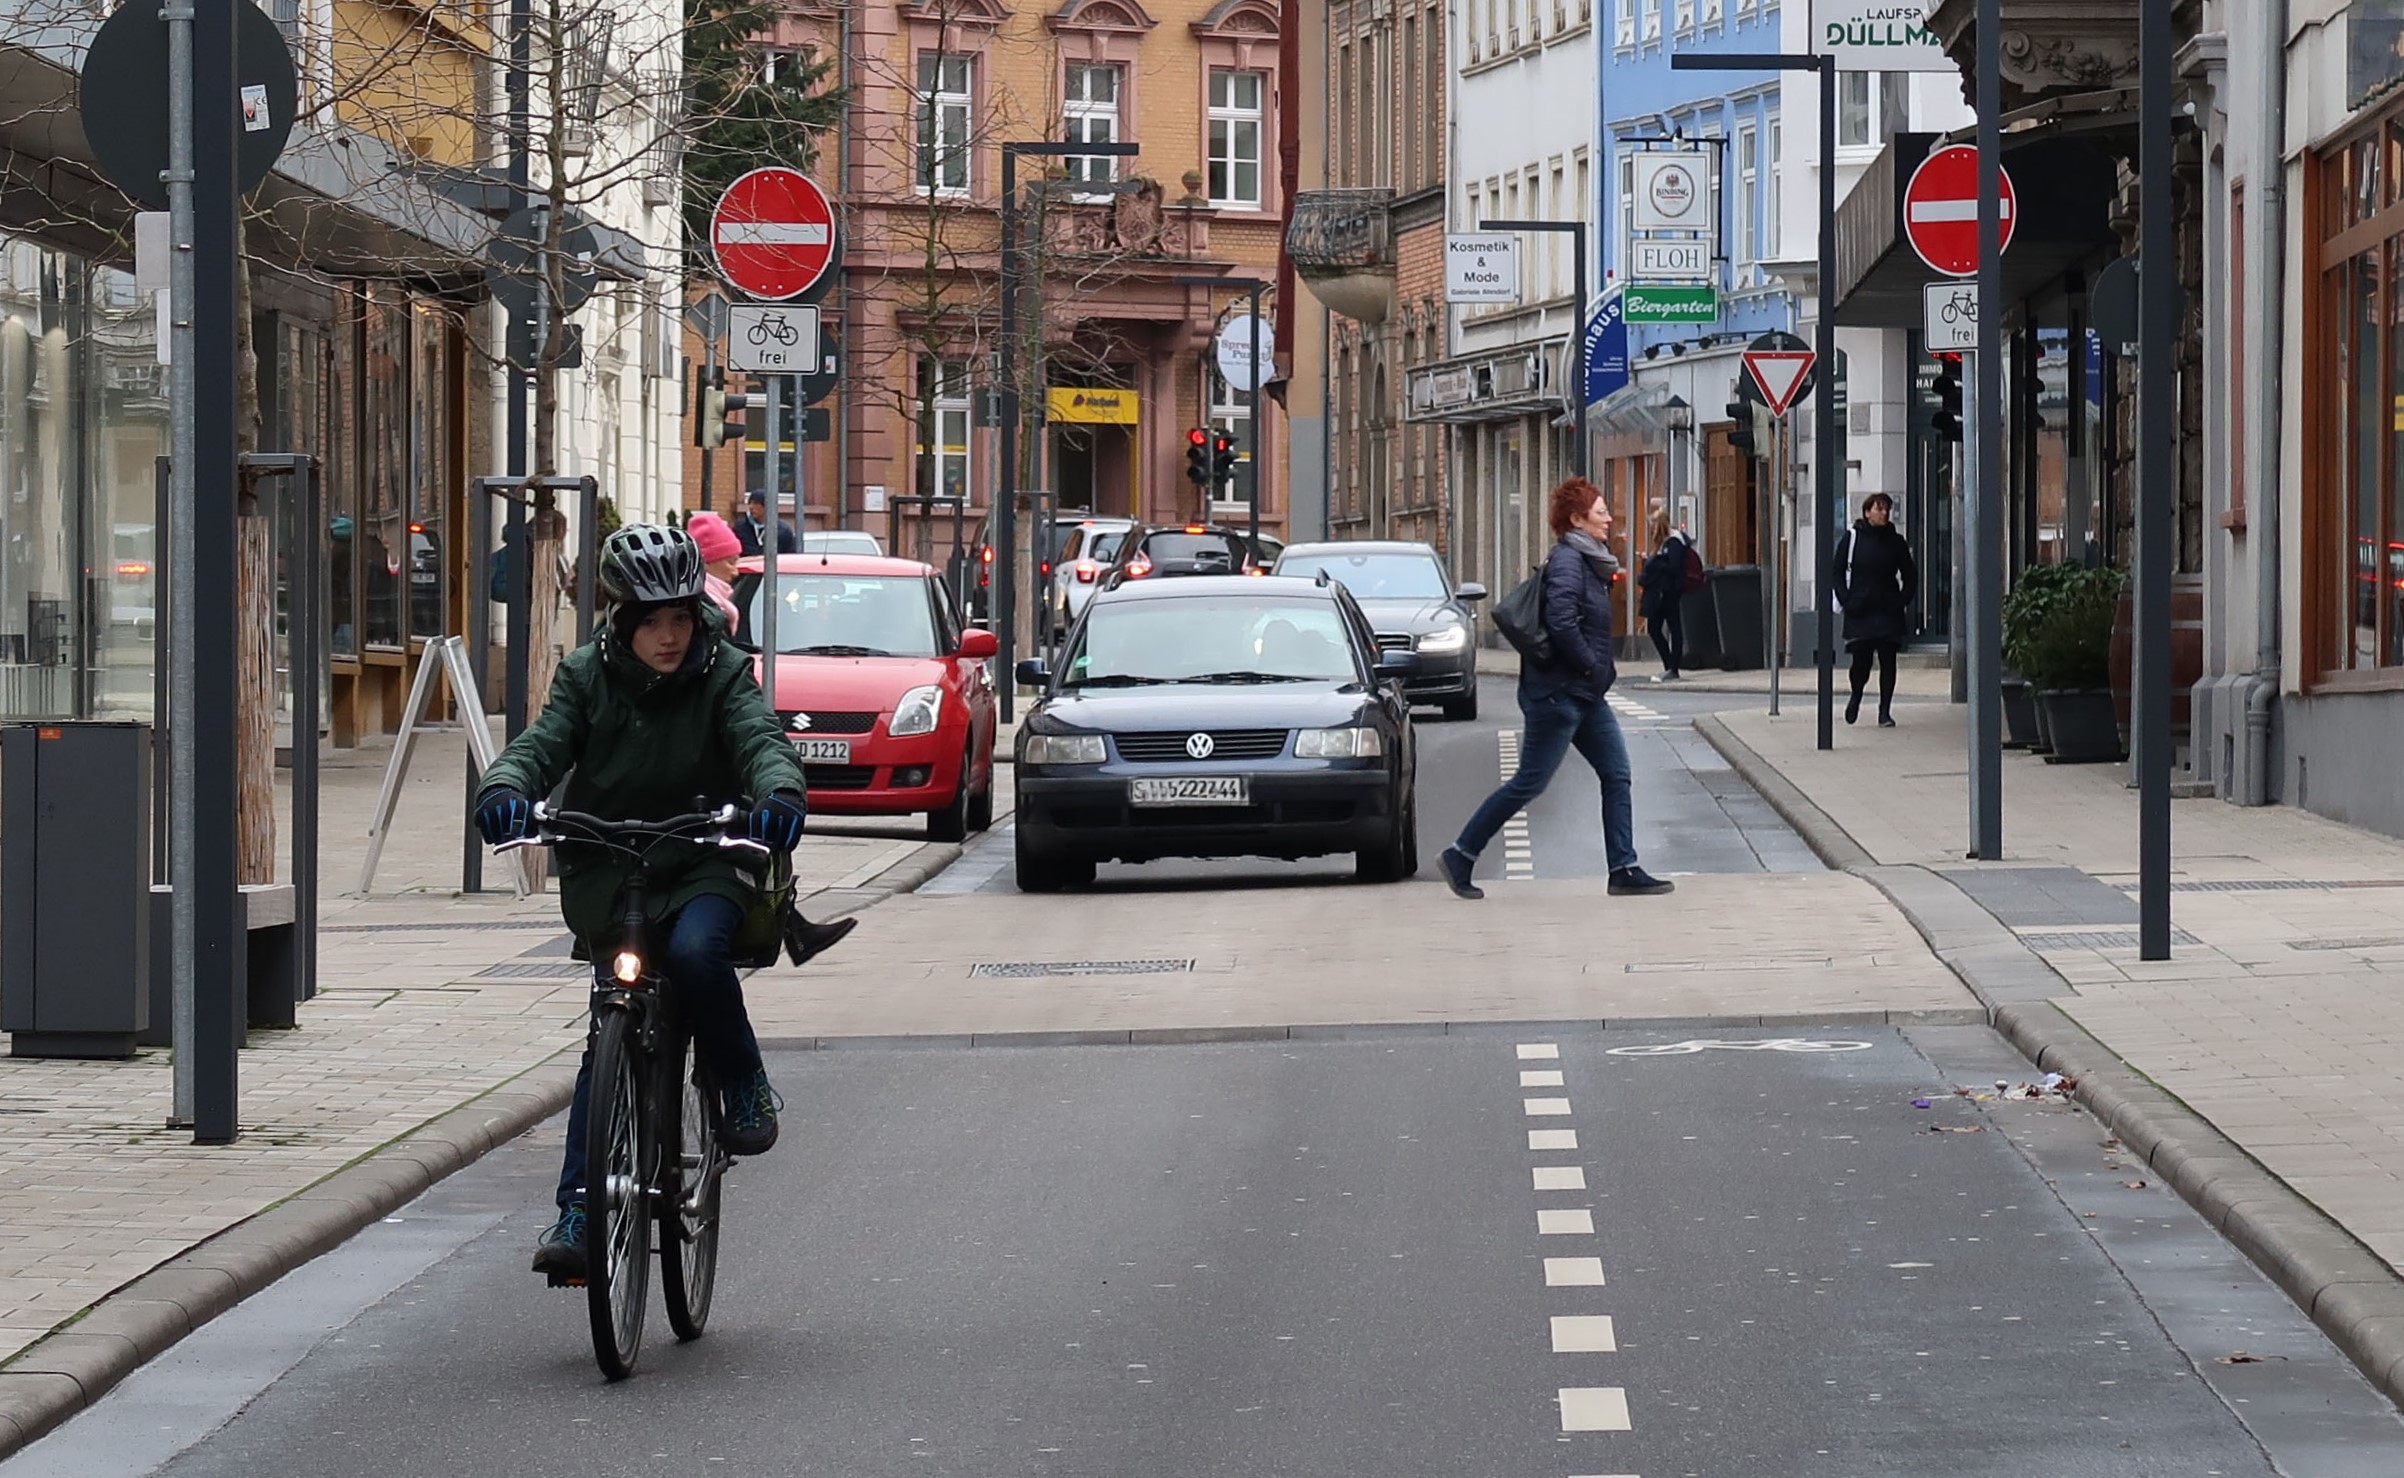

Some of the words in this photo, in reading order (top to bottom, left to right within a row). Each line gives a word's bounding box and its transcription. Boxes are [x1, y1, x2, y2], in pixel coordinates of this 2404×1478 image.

[1449, 241, 1510, 253] Kosmetik
[1476, 255, 1487, 268] &
[1643, 248, 1700, 269] FLOH
[1464, 271, 1500, 283] Mode
[1626, 296, 1714, 318] Biergarten
[1951, 326, 1975, 342] frei
[759, 349, 787, 365] frei
[811, 742, 848, 759] 1212
